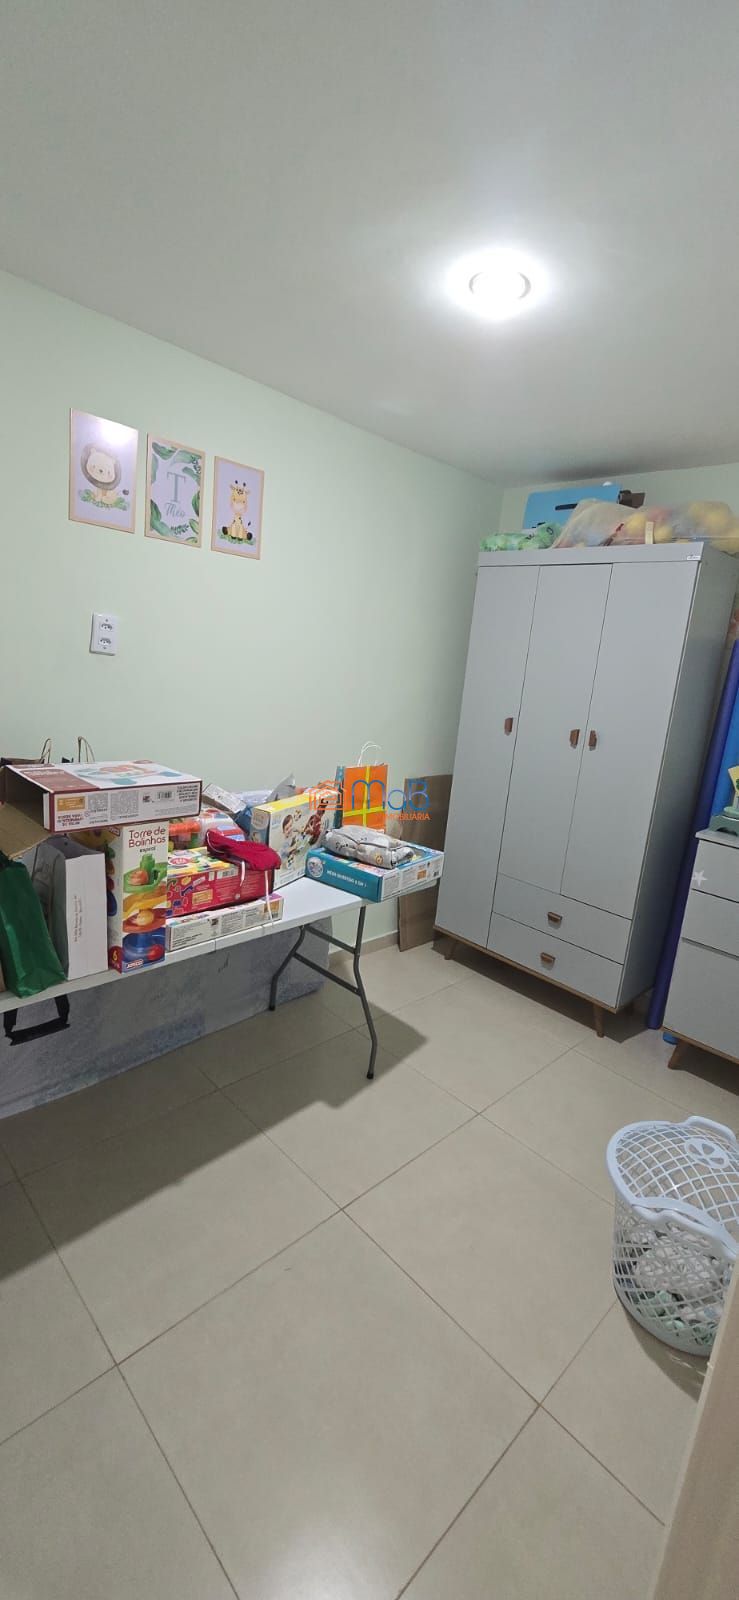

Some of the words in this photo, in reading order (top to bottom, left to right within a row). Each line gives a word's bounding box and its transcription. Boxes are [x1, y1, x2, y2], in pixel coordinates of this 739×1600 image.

[167, 471, 186, 503] T
[129, 829, 153, 840] Torre
[153, 826, 166, 836] de
[128, 835, 167, 849] Bolinhas
[112, 950, 118, 961] 6
